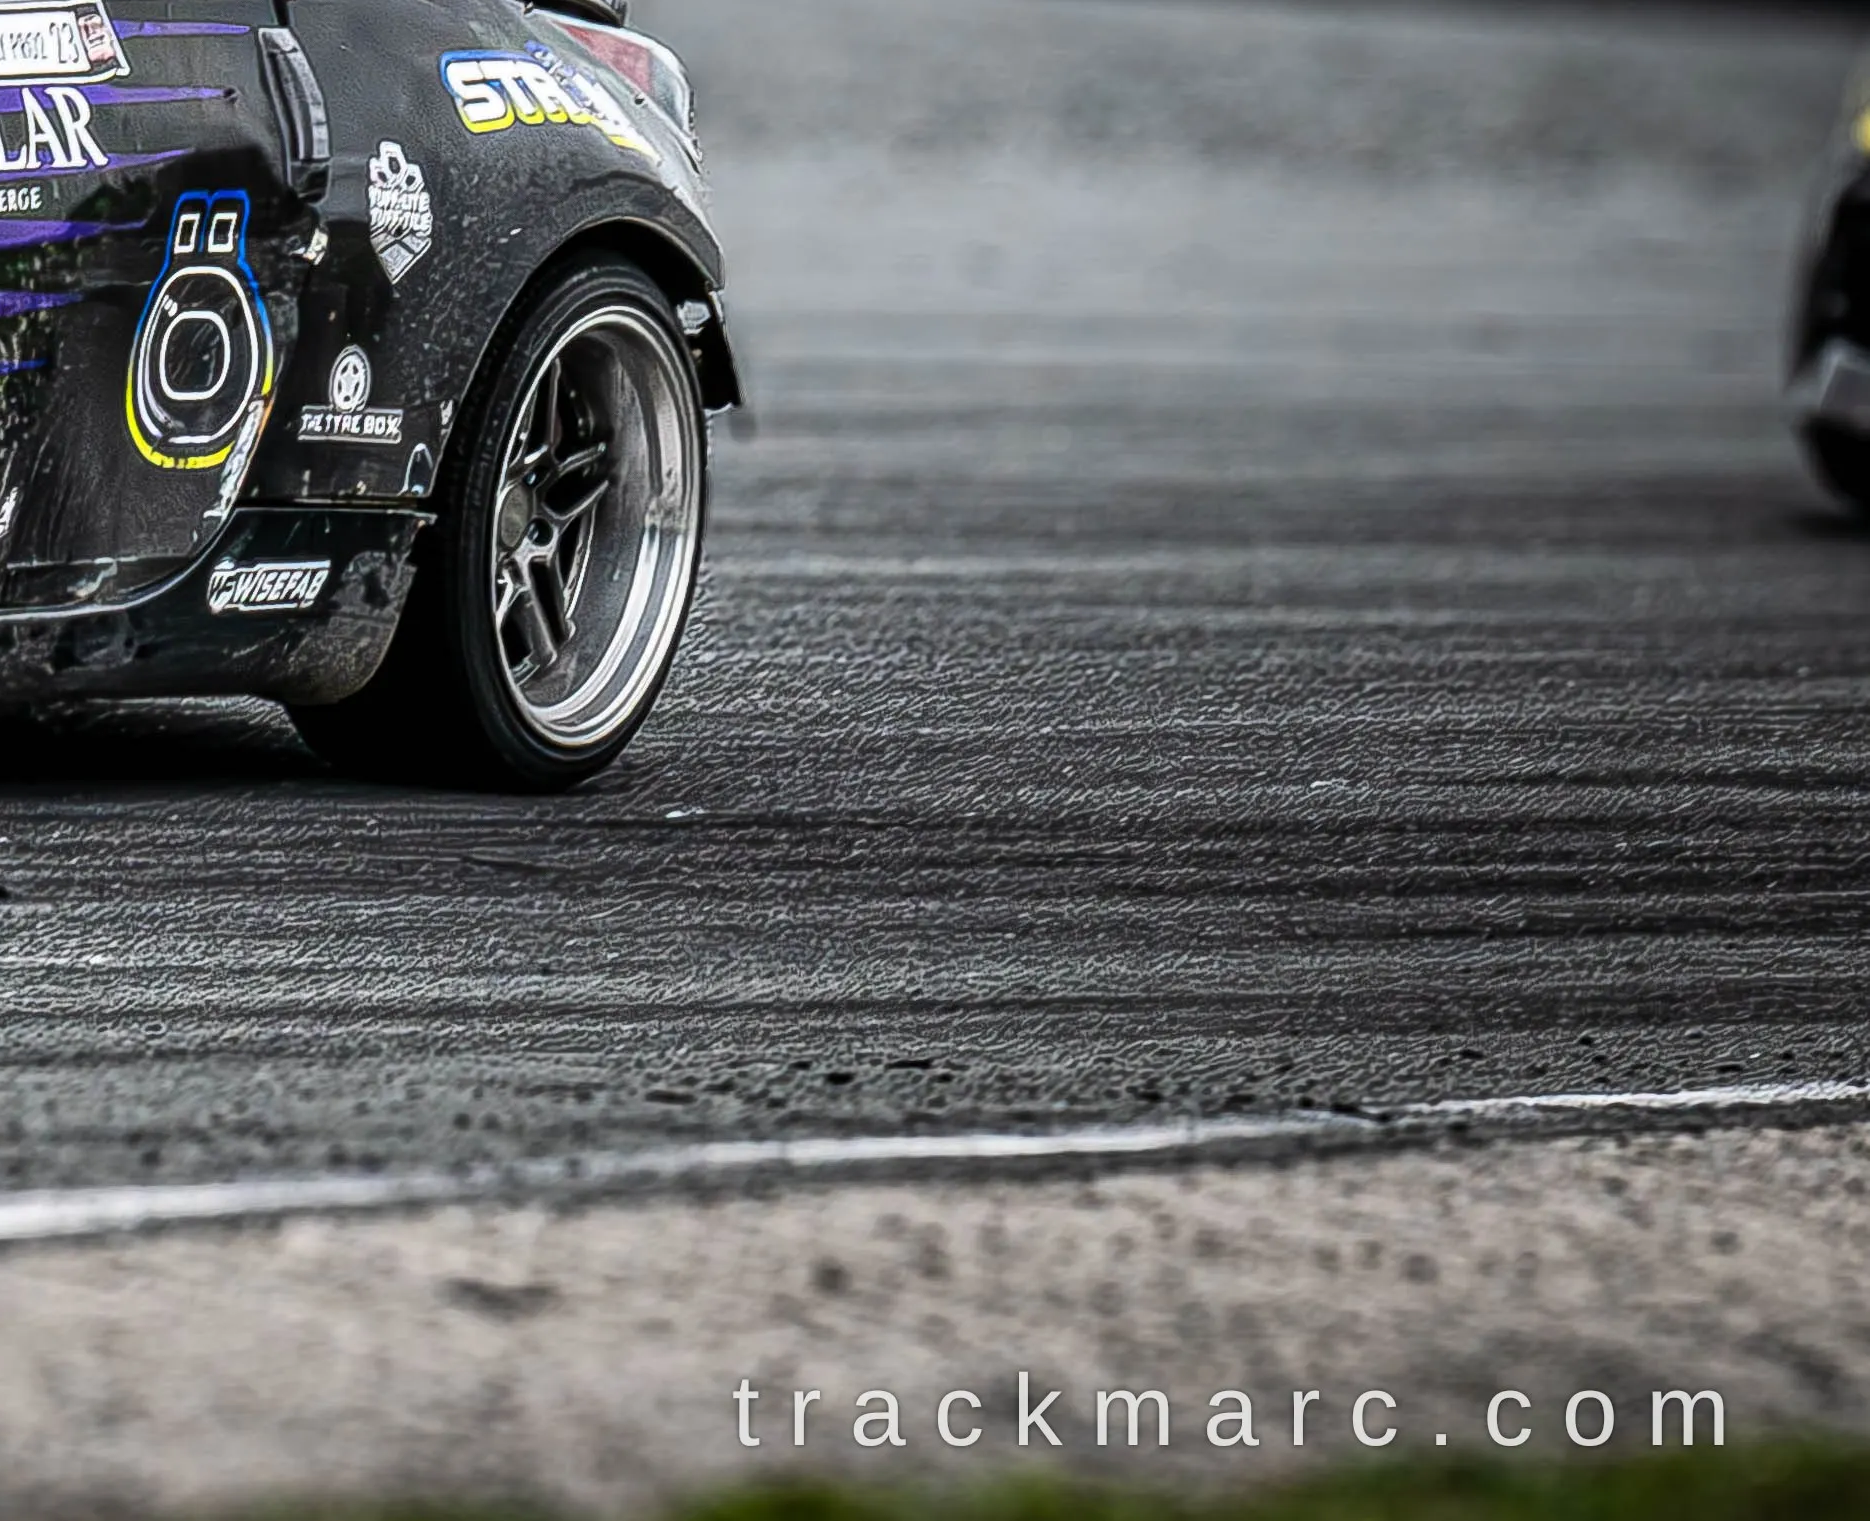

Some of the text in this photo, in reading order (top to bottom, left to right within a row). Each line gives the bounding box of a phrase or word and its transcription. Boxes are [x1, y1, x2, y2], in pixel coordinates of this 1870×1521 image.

[48, 21, 80, 64] 23
[363, 414, 401, 436] BOX
[233, 569, 329, 603] WISEFAB
